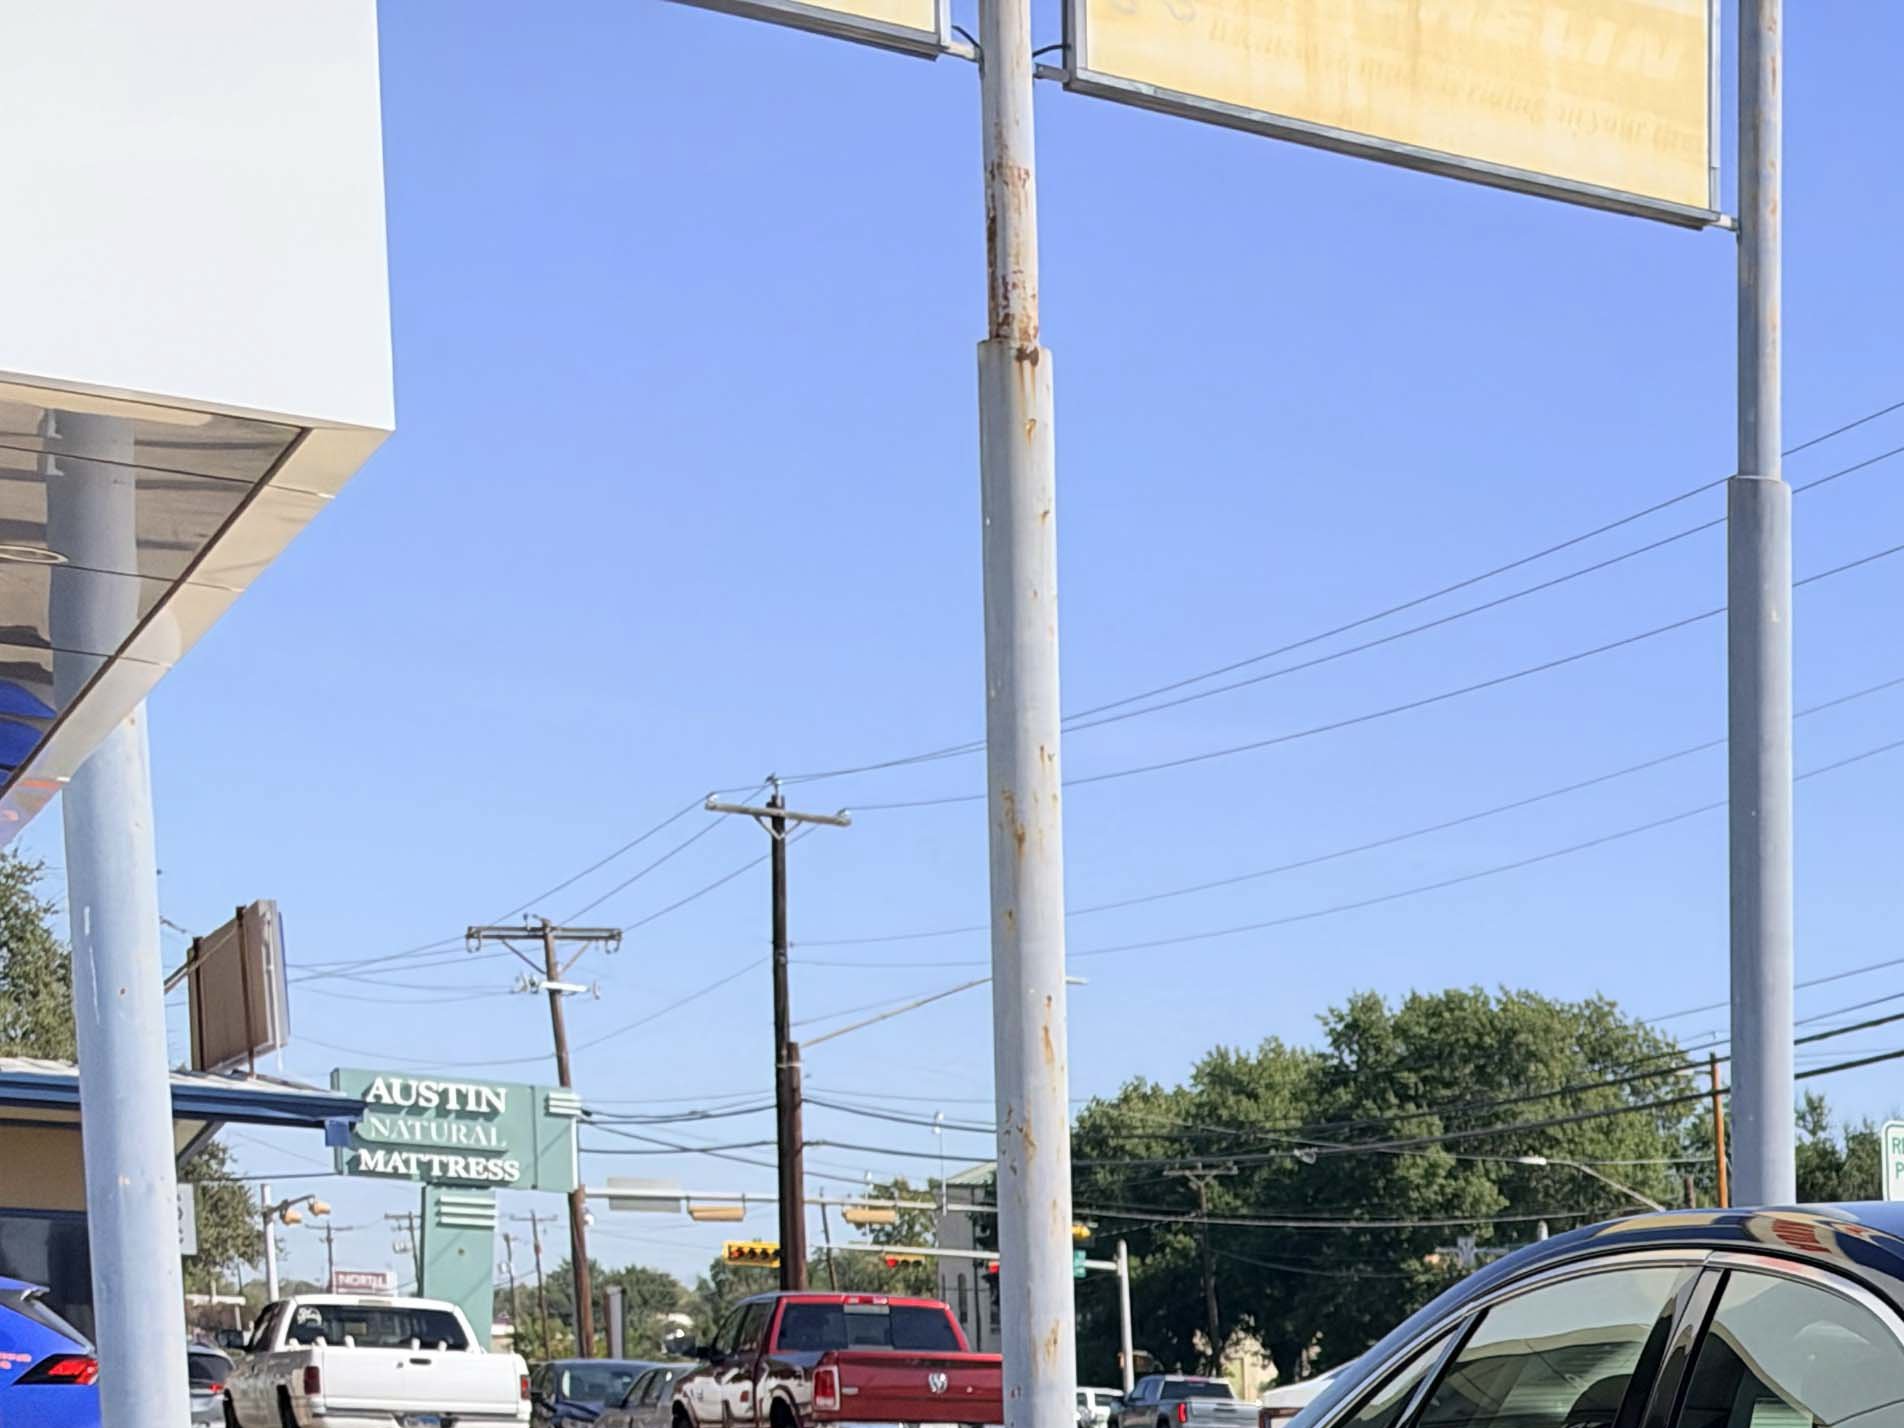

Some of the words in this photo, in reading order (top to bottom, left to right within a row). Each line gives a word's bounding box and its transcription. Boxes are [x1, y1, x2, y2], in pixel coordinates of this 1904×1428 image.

[365, 1076, 508, 1113] AUSTIN
[369, 1116, 508, 1148] NATURAL
[357, 1148, 521, 1182] MATTRESS
